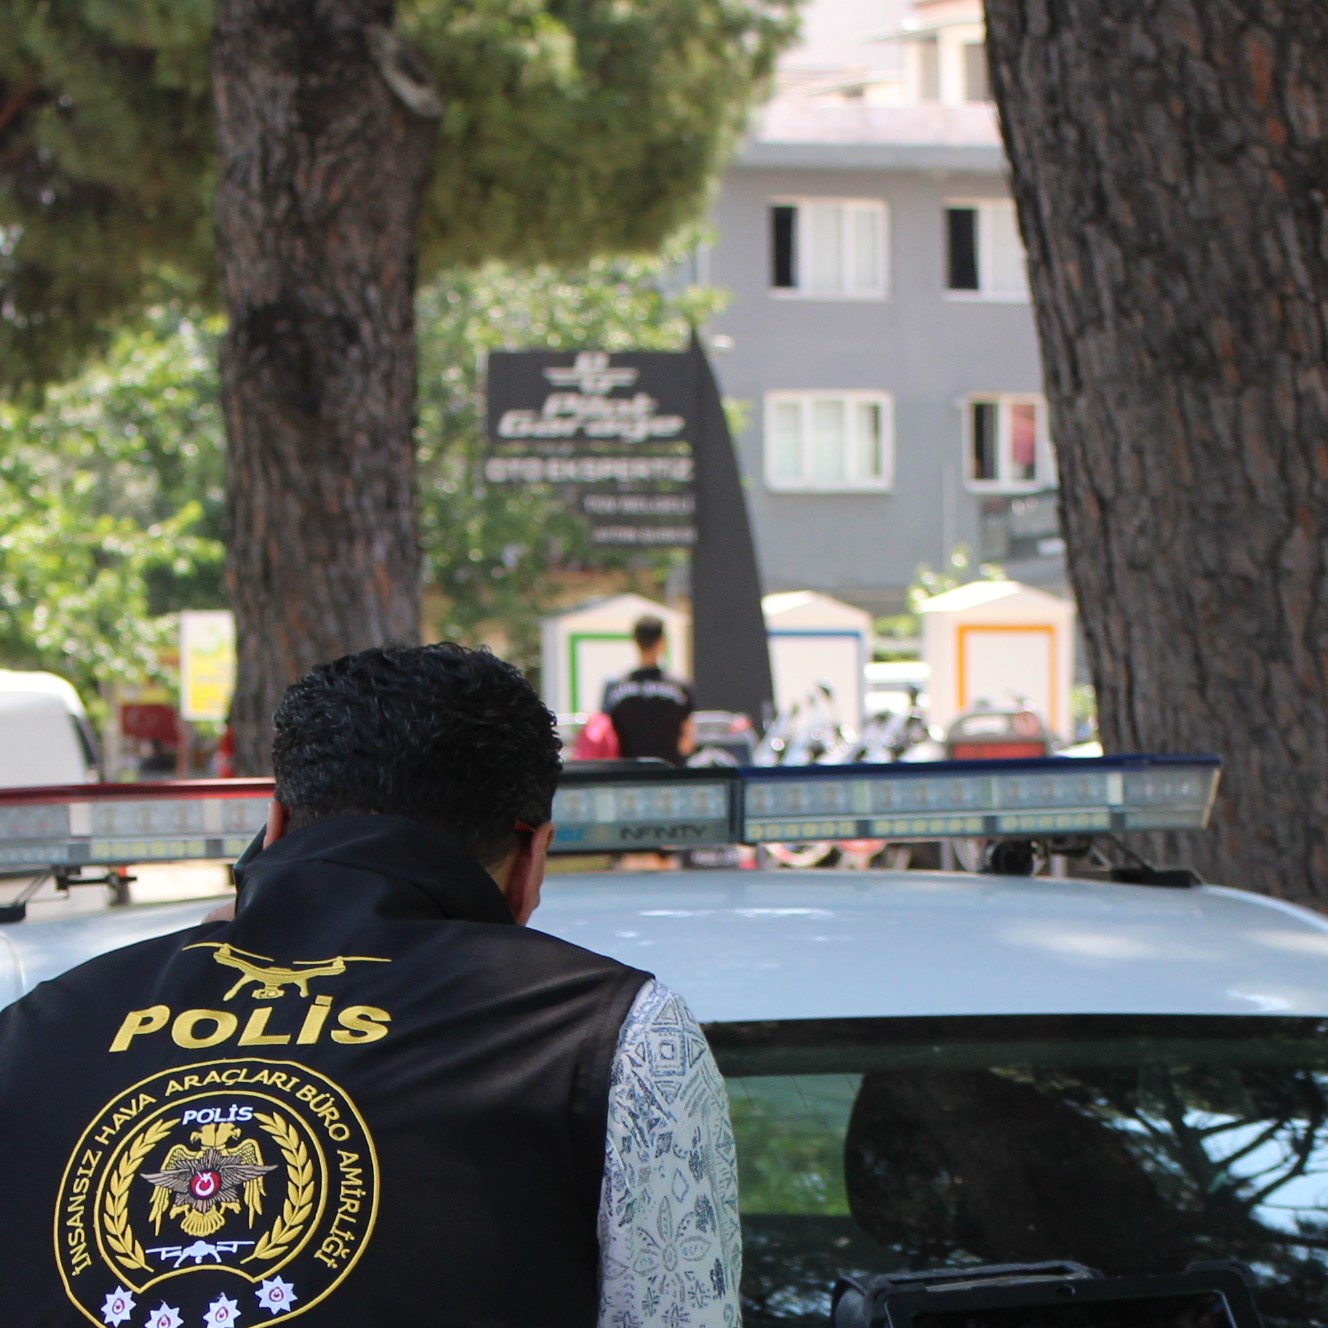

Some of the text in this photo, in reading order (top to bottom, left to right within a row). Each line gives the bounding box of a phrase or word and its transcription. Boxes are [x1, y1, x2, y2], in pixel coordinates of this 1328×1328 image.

[108, 995, 393, 1053] POLİS
[181, 1103, 254, 1126] POLİS
[67, 1068, 368, 1276] İNSANSIZ HAVA ARAÇLARI BÜRO AMİRLİĞİ
